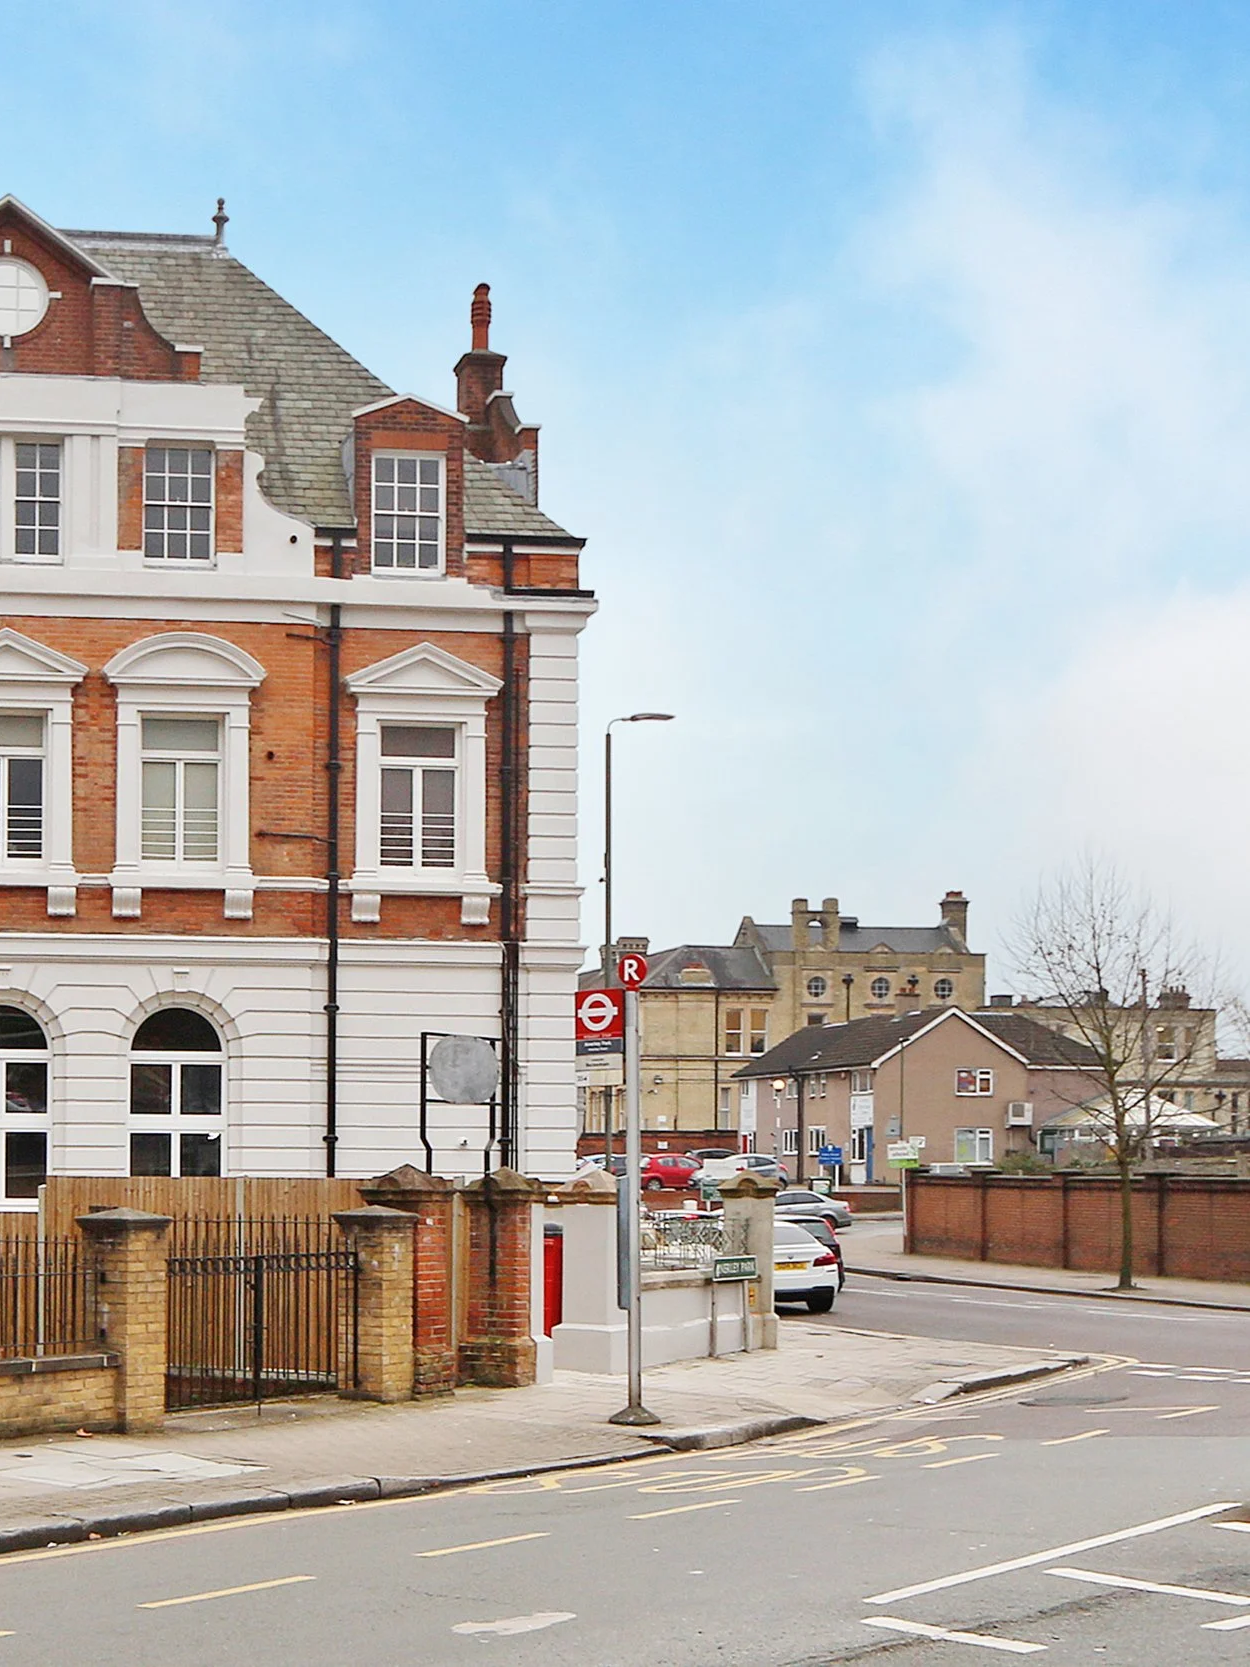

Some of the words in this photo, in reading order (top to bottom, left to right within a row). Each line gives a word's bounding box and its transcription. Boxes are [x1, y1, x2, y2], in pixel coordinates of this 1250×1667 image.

[624, 959, 640, 982] R
[740, 1261, 755, 1272] PARK
[464, 1466, 867, 1495] STOP
